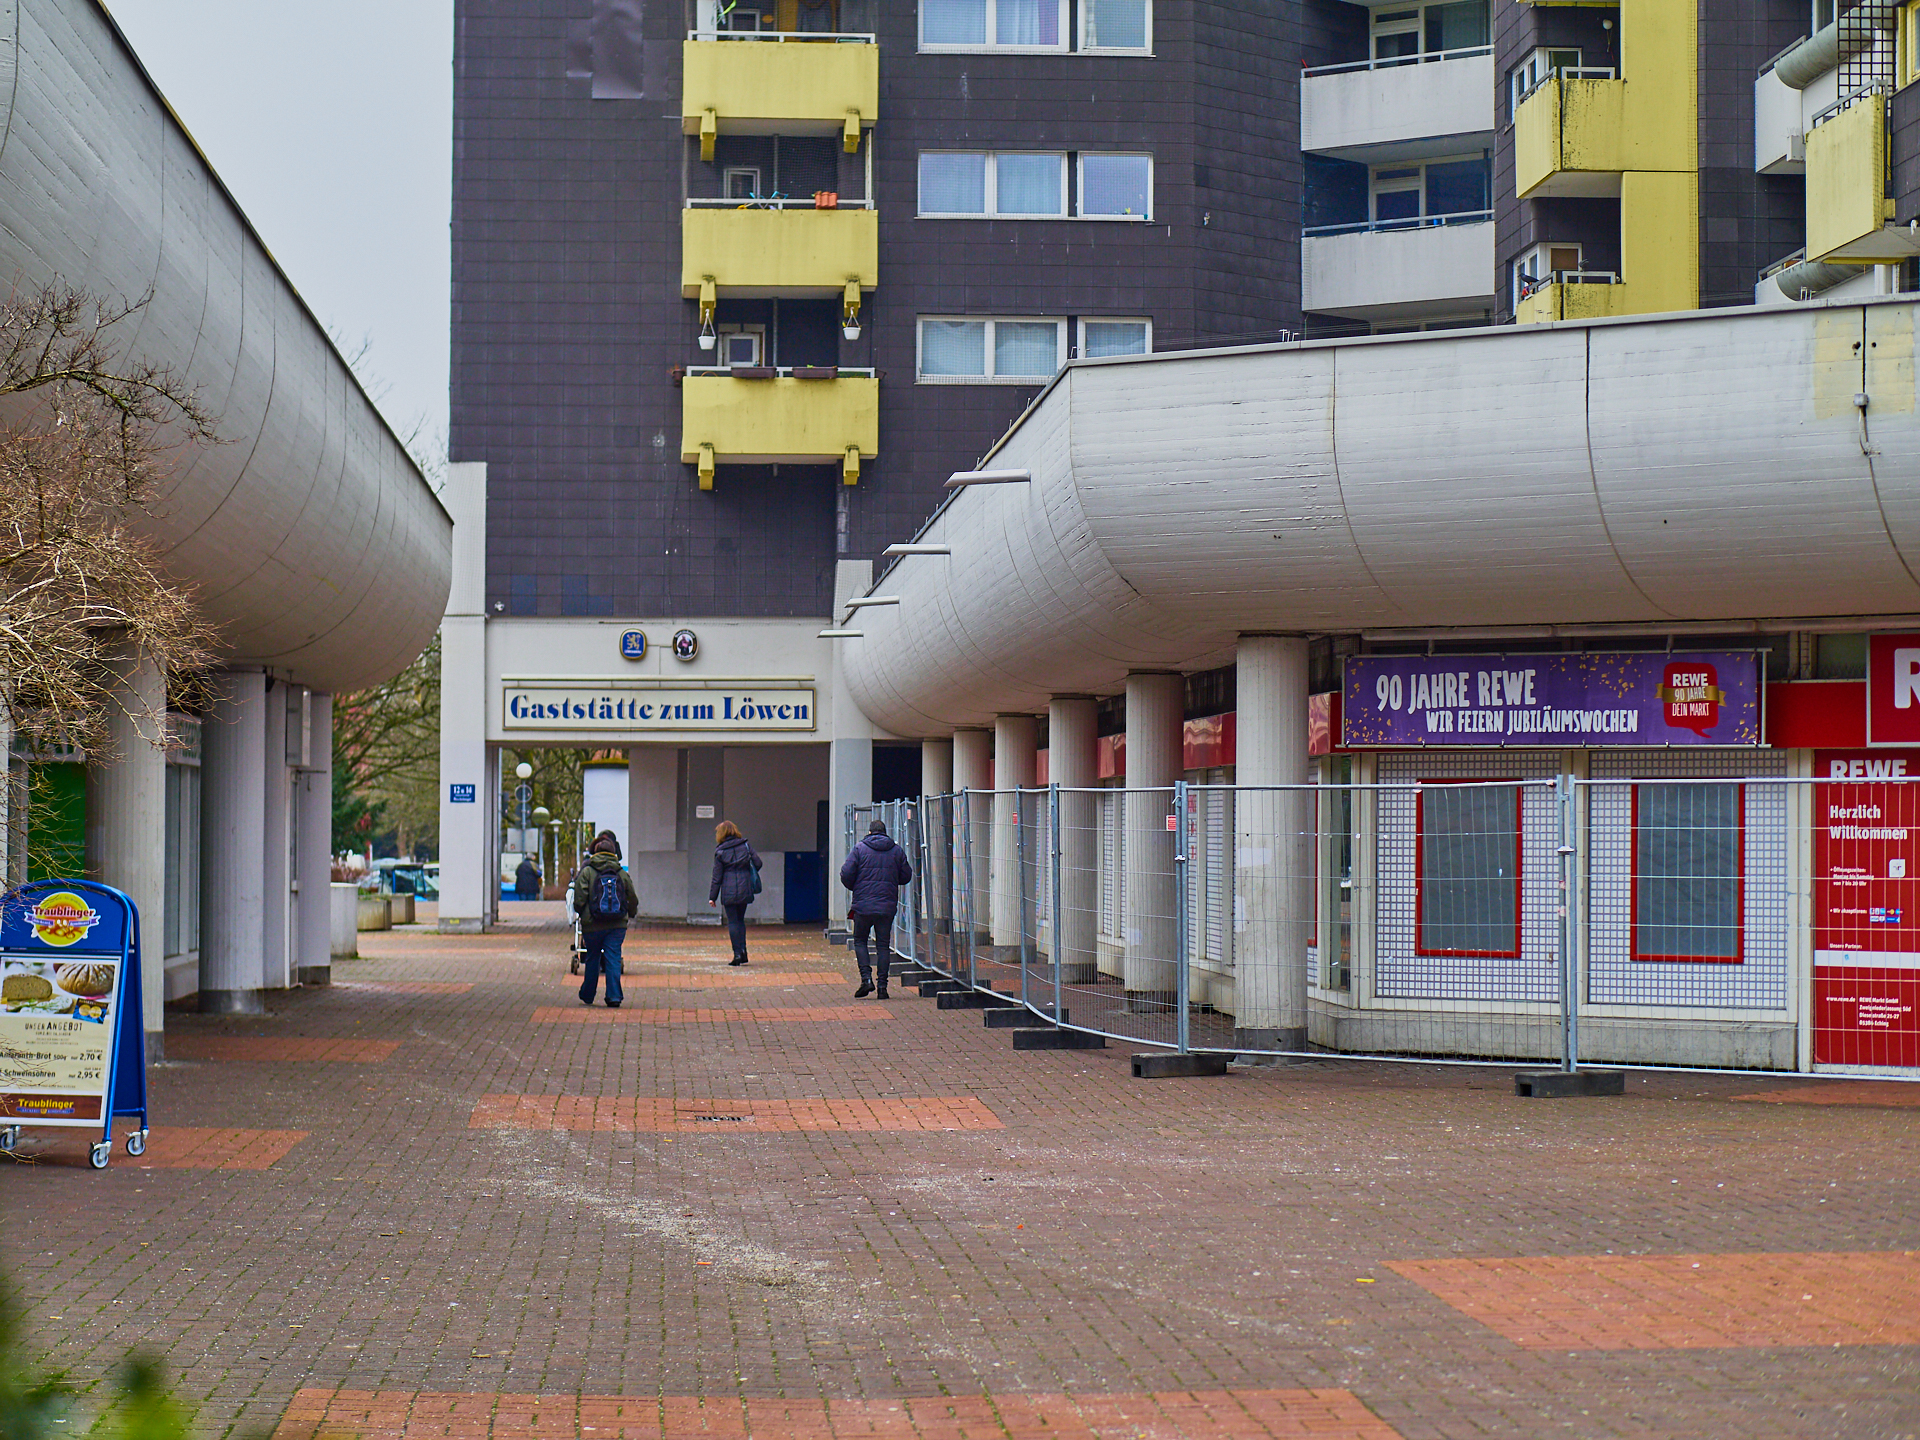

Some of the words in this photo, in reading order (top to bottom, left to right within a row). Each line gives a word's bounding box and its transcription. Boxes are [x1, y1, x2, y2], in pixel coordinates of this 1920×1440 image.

[1672, 673, 1708, 687] REWE
[1376, 674, 1402, 712] 90
[1408, 672, 1470, 714] JAHRE
[1477, 669, 1536, 706] REWE
[1674, 688, 1685, 701] 90
[1687, 686, 1707, 701] JAHRE
[510, 694, 653, 720] Gaststätte
[659, 703, 715, 720] zum
[723, 696, 810, 721] Löwen
[1672, 703, 1687, 716] DEIN
[1689, 703, 1709, 716] MARKT
[1426, 710, 1453, 732] WIR
[1458, 710, 1503, 732] FEIERN
[1507, 705, 1638, 735] JUBILÄUMSWOCHEN
[1830, 759, 1907, 784] REWE
[1830, 804, 1881, 819] Herzlich
[1830, 825, 1908, 840] Willkommen
[33, 906, 94, 918] Traublinger
[46, 1021, 83, 1031] ANGEBOT
[79, 1053, 95, 1061] 2,70
[97, 1053, 102, 1061] €
[4, 1069, 56, 1078] Schweinsohren
[77, 1070, 93, 1079] 2,95
[95, 1071, 100, 1079] €
[18, 1098, 74, 1109] Traublinger
